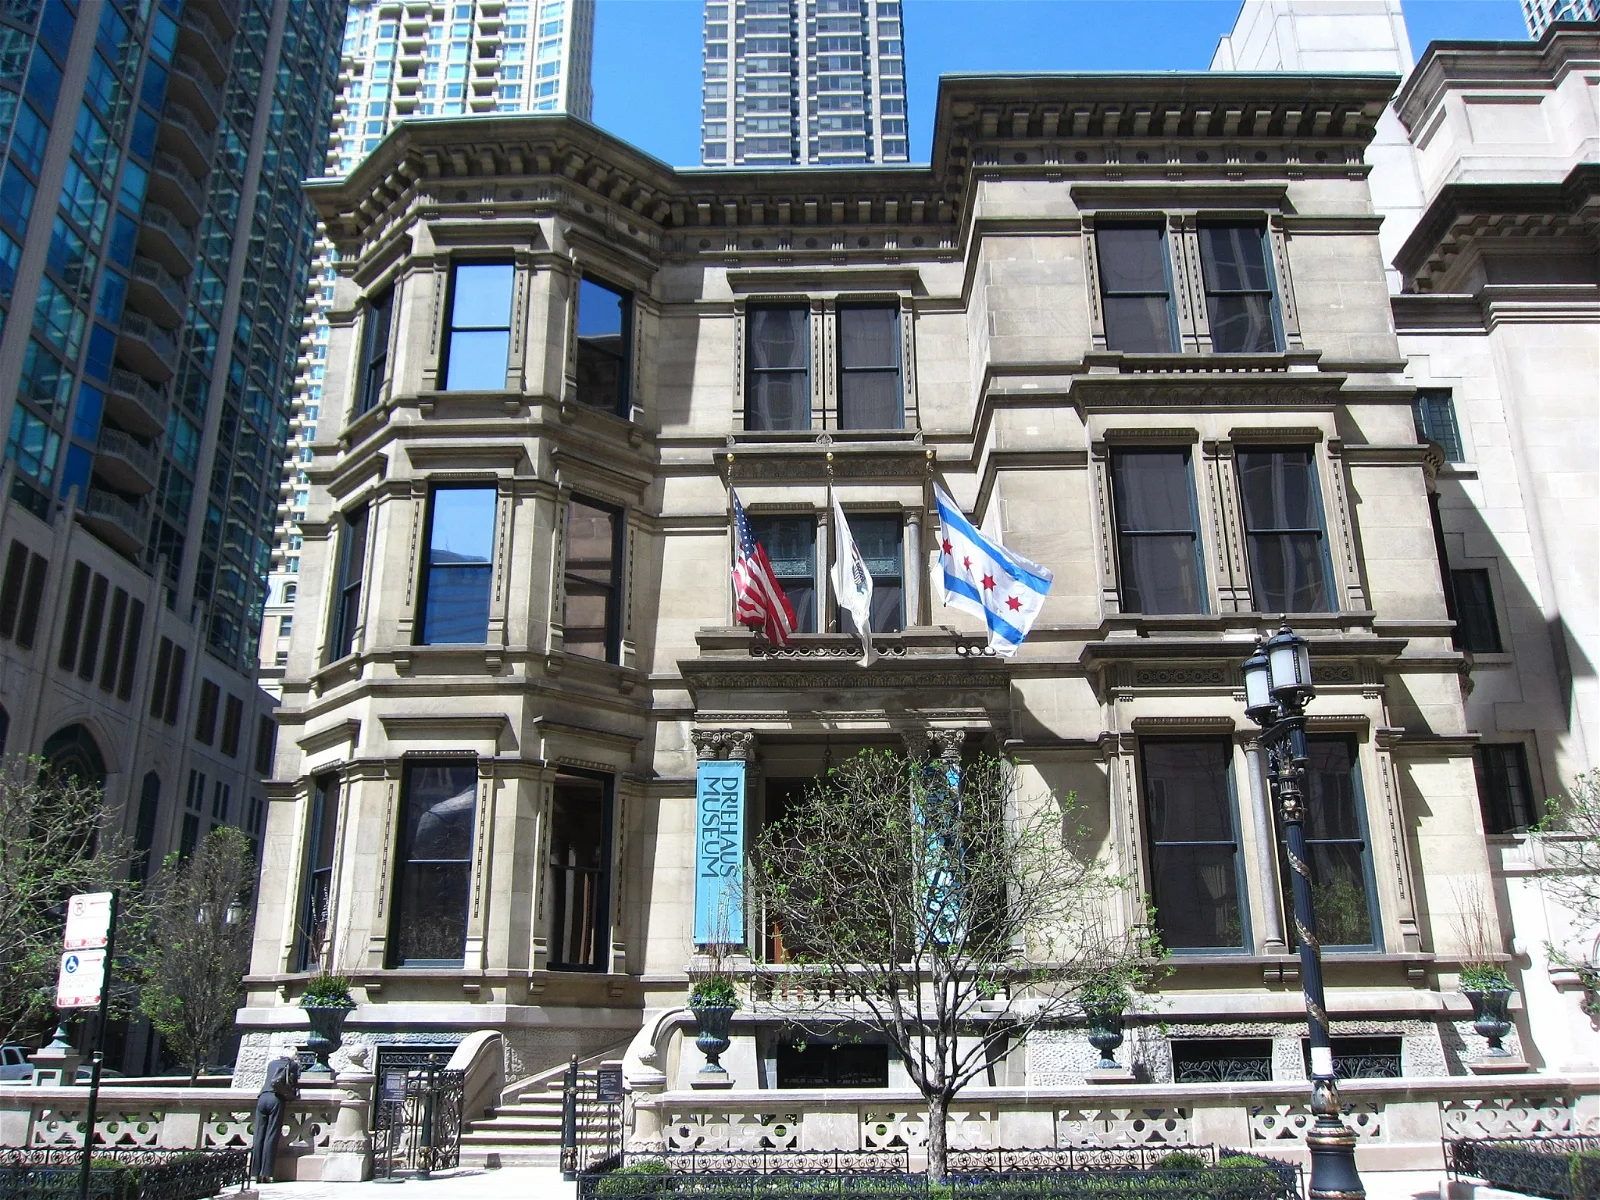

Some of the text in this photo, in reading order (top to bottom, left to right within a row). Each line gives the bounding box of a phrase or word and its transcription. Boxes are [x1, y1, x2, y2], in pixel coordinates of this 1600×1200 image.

[702, 777, 720, 877] MUSEUM
[719, 777, 738, 877] DRIEHAUS
[68, 938, 103, 947] TOW ZONE
[61, 996, 96, 1005] TOW ZONE
